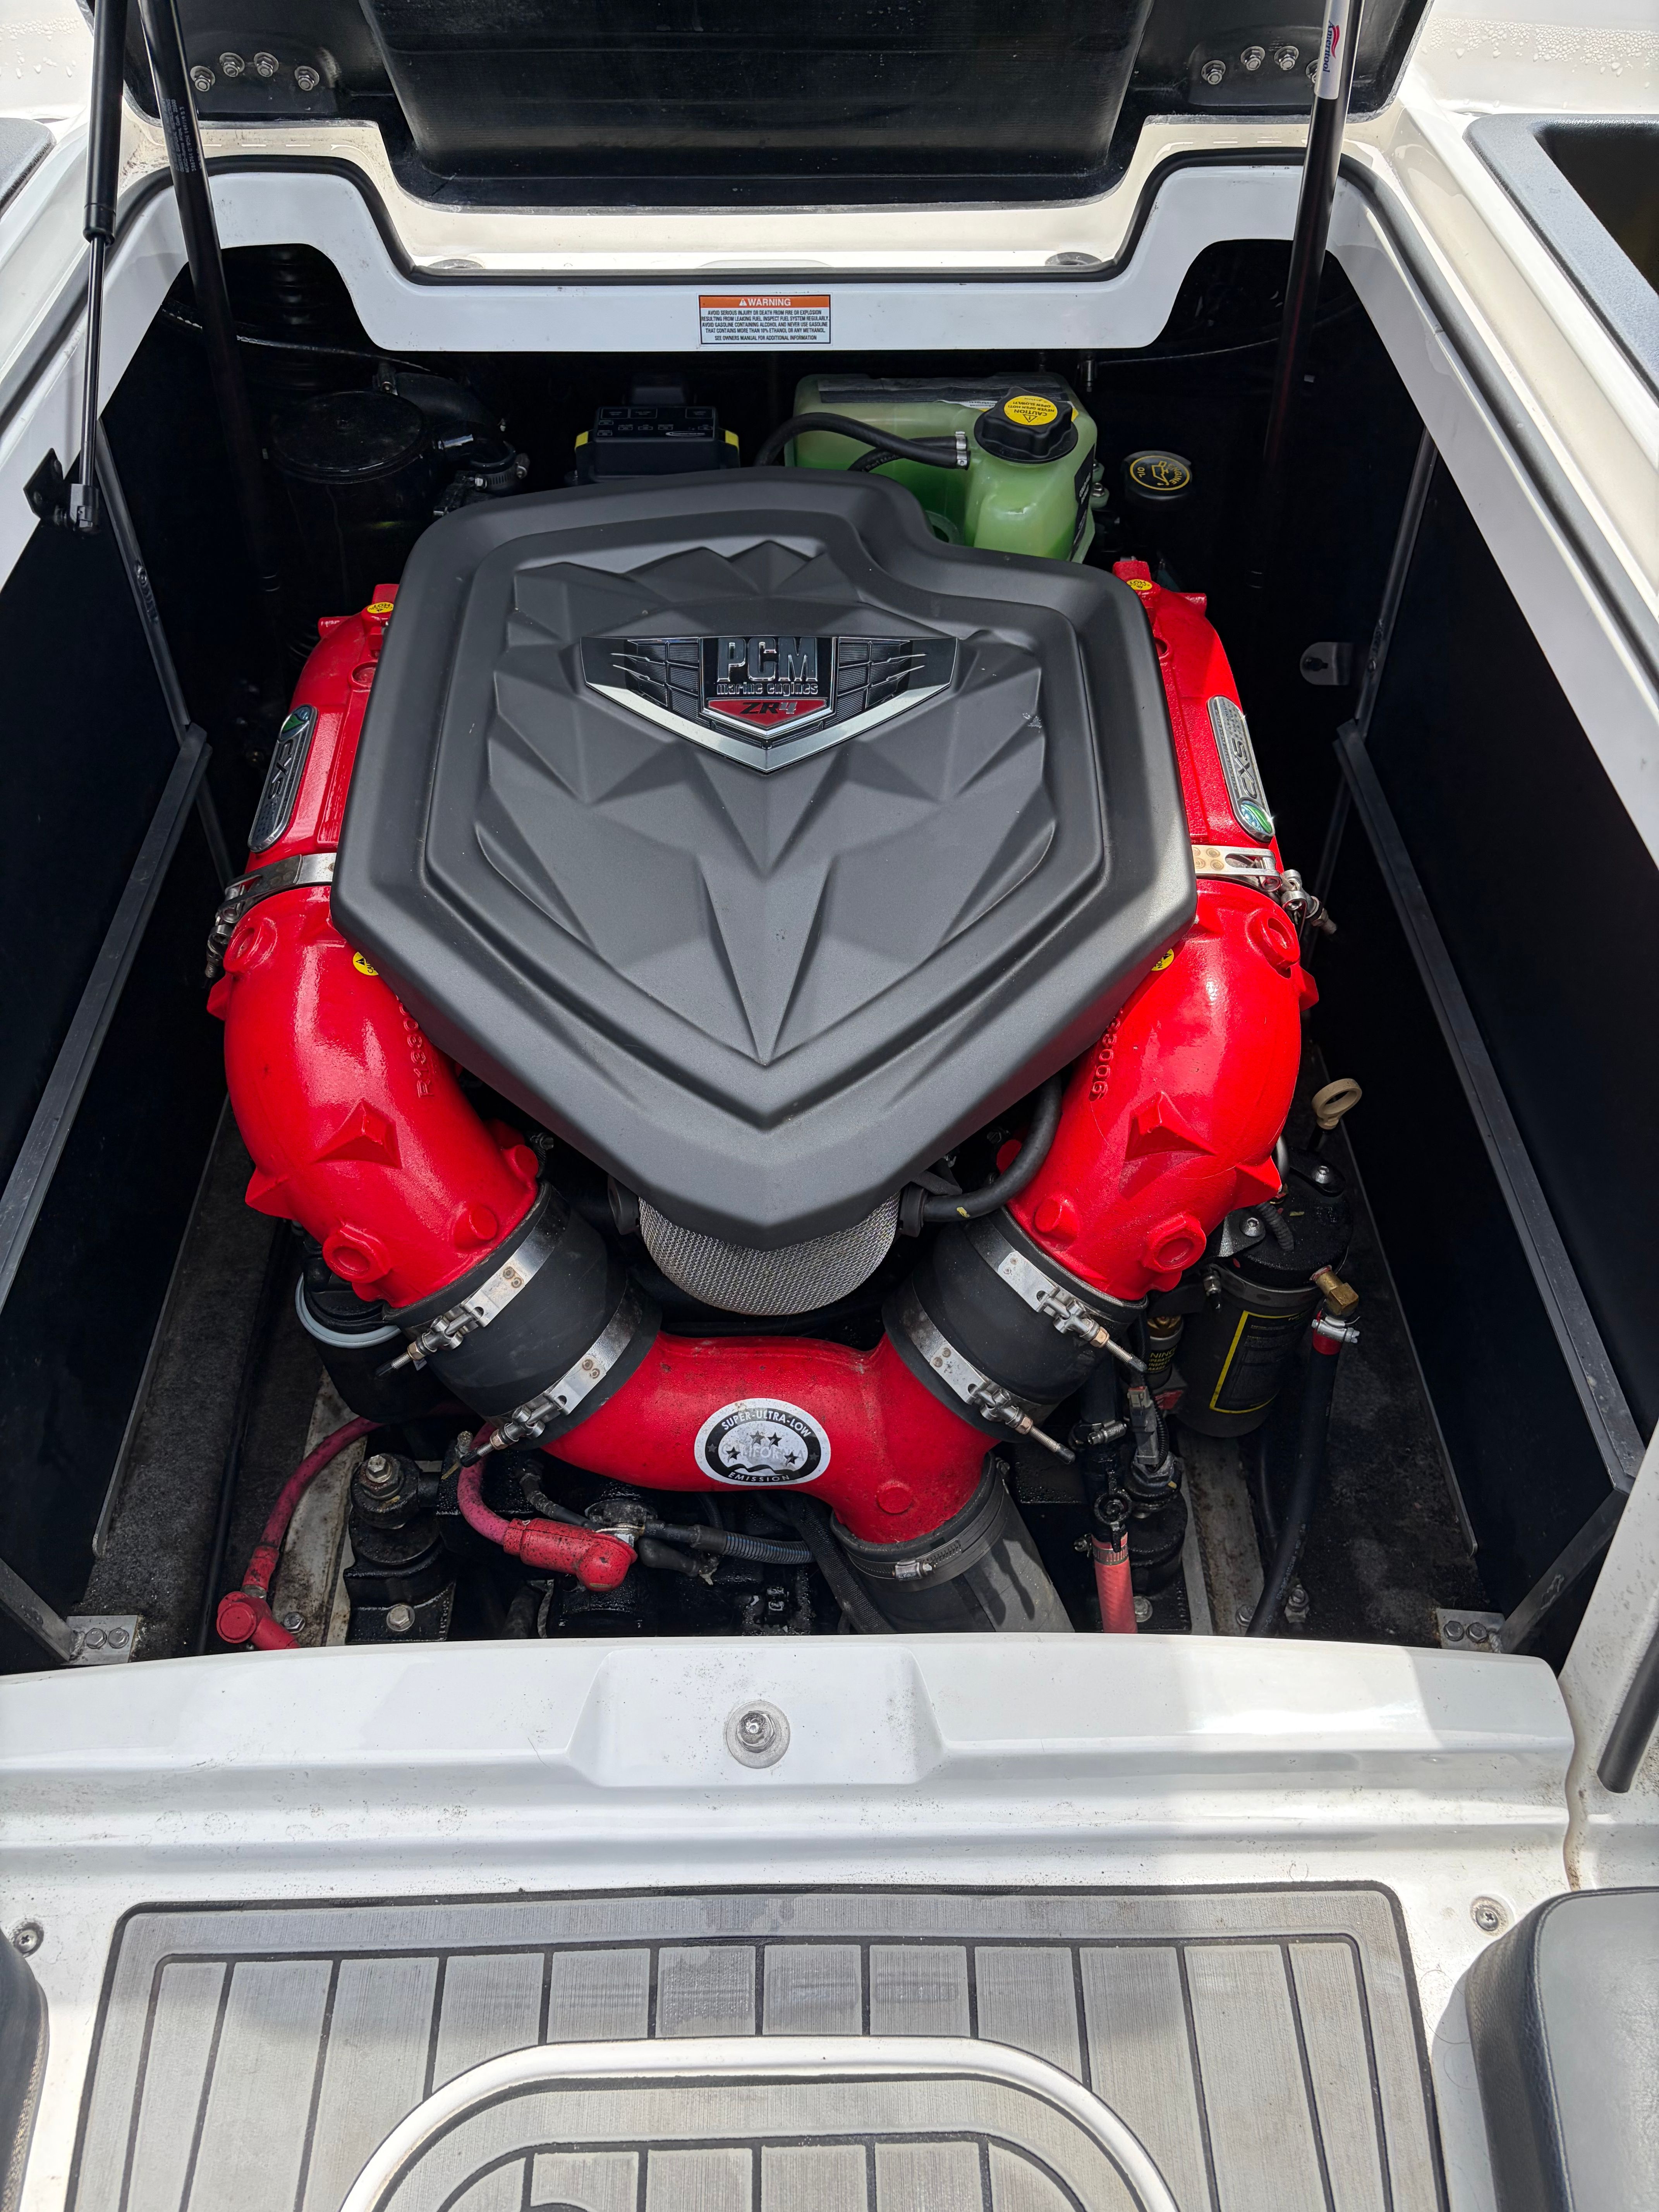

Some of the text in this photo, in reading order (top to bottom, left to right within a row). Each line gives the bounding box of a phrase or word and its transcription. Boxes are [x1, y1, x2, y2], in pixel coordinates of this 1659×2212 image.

[1137, 467, 1146, 477] OIL
[1168, 464, 1182, 484] ENGINE
[717, 637, 818, 682] PCM
[716, 683, 818, 697] marine engines
[739, 701, 797, 715] ZR4
[721, 1410, 812, 1437] SUPER-ULTRA-LOW
[728, 1472, 790, 1482] EMISSION
